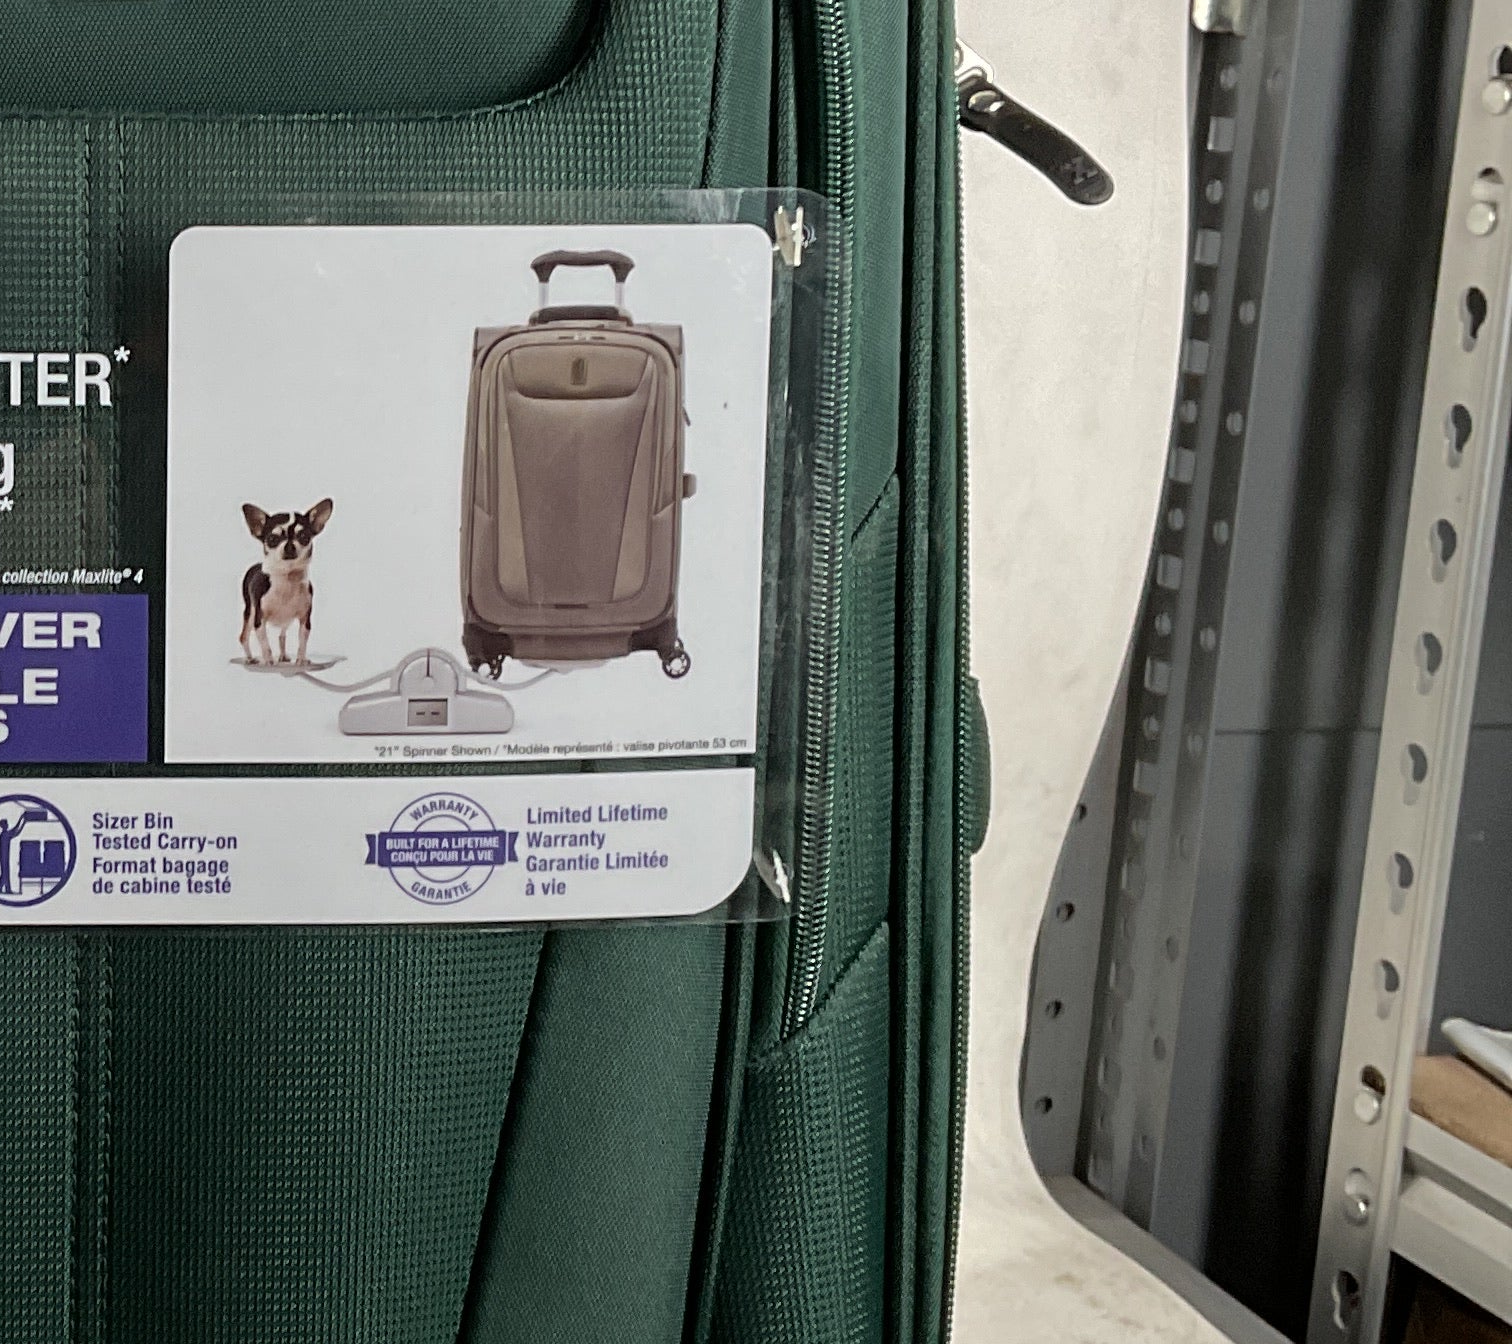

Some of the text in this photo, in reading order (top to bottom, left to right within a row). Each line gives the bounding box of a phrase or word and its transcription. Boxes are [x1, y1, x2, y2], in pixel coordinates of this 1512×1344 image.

[2, 568, 69, 585] collection
[133, 568, 144, 585] 4
[403, 745, 448, 758] Spinner
[451, 744, 491, 757] Shown
[553, 741, 613, 755] représenté
[623, 740, 656, 752] valise
[658, 738, 709, 752] pivotante
[712, 737, 726, 749] 53
[729, 738, 747, 748] cm
[410, 799, 479, 821] WARRANTY
[527, 804, 668, 824] Limited Lifetime
[92, 812, 173, 830] Sizer Bin
[92, 832, 237, 853] Tested Carry-on
[386, 837, 499, 850] BUILT FOR A LIFETIME
[527, 830, 606, 850] Warranty
[391, 849, 494, 864] CONÇU POUR LA VIE
[526, 850, 669, 872] Garantie Limitée
[92, 857, 229, 878] Format bagage
[92, 876, 231, 894] de cabine testé
[411, 880, 472, 900] GARANTIE
[525, 878, 566, 896] à vie
